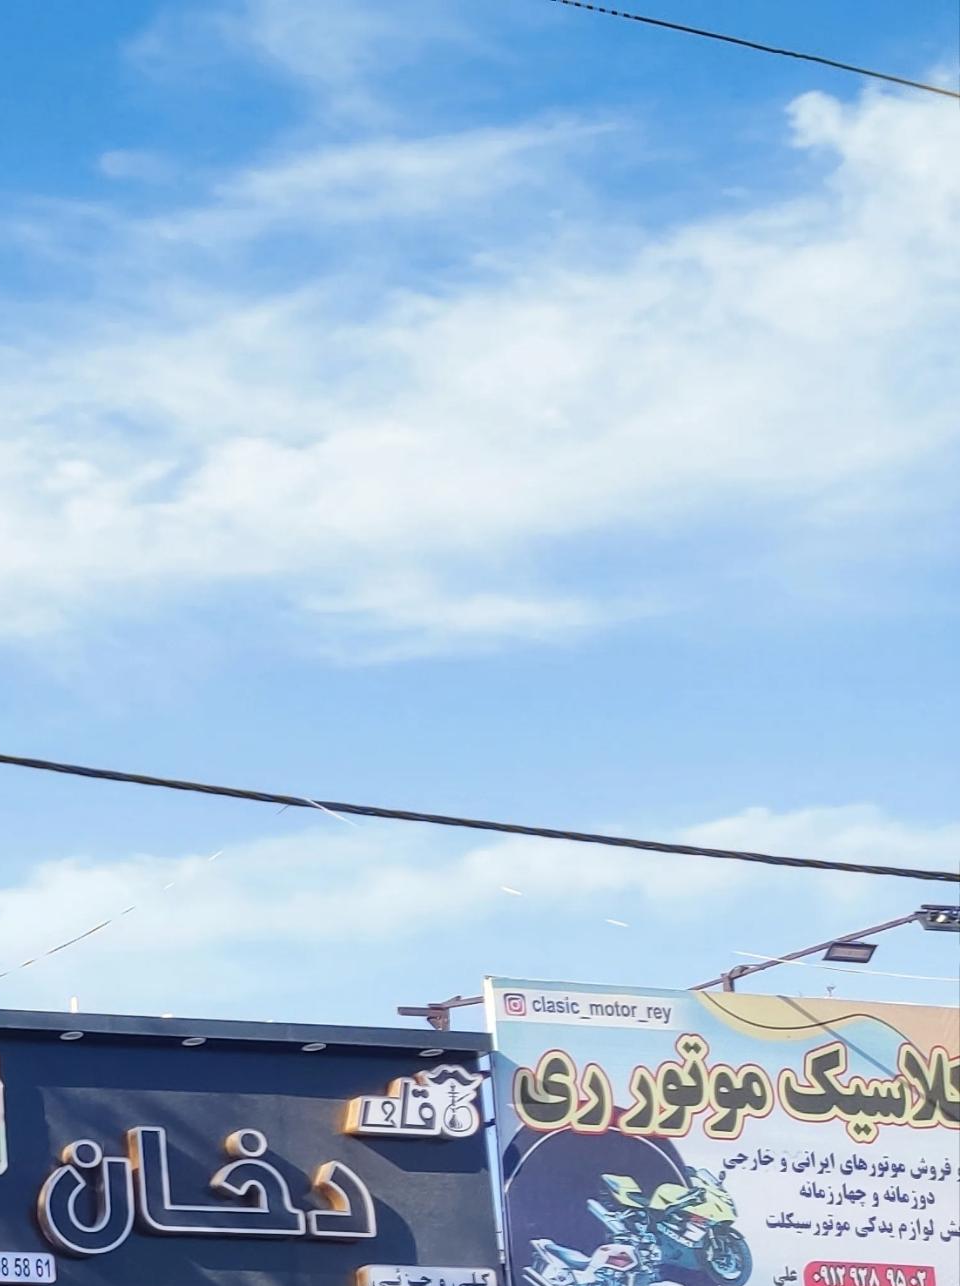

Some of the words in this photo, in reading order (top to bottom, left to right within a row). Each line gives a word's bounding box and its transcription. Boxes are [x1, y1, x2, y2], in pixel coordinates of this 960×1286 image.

[532, 996, 672, 1024] clasic_motor_rey
[514, 1049, 614, 1135] ری
[618, 1033, 774, 1140] موتور
[722, 1149, 775, 1172] خارجی
[780, 1156, 788, 1173] و
[791, 1151, 835, 1174] ایرانی
[910, 1157, 952, 1181] فروش
[38, 1126, 378, 1255] دخان
[871, 1191, 879, 1207] و
[854, 1216, 893, 1238] یدکی
[898, 1218, 934, 1242] لوازم
[14, 1257, 31, 1278] 58
[35, 1258, 51, 1278] 61
[773, 1265, 798, 1286] علی
